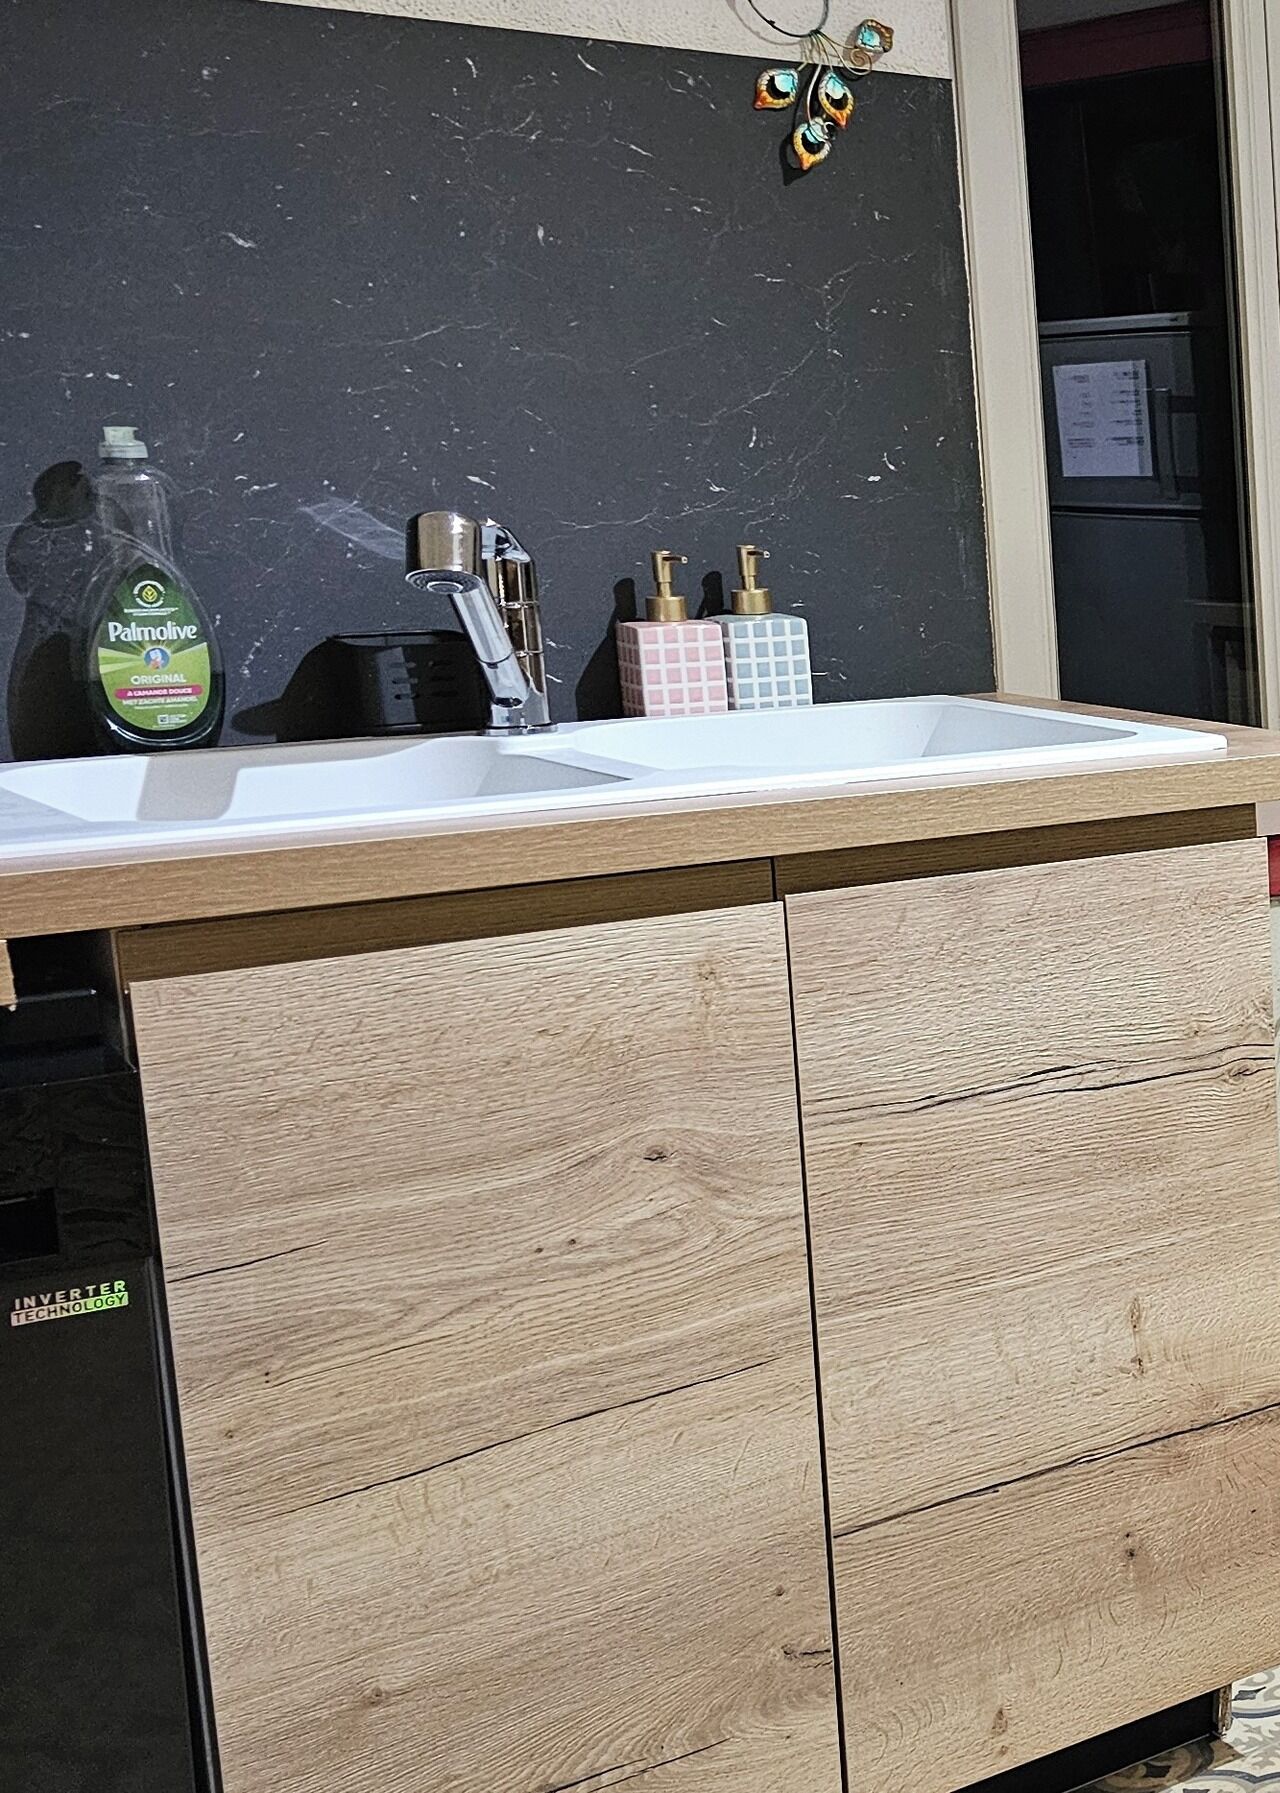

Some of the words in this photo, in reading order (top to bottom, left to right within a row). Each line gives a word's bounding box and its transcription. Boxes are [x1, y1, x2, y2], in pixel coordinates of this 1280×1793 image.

[108, 620, 198, 642] Palmolive
[130, 673, 187, 685] ORIGINAL
[168, 687, 193, 695] DOUCE
[15, 1280, 126, 1310] INVERTER
[13, 1293, 126, 1323] TECHNOLOGY
